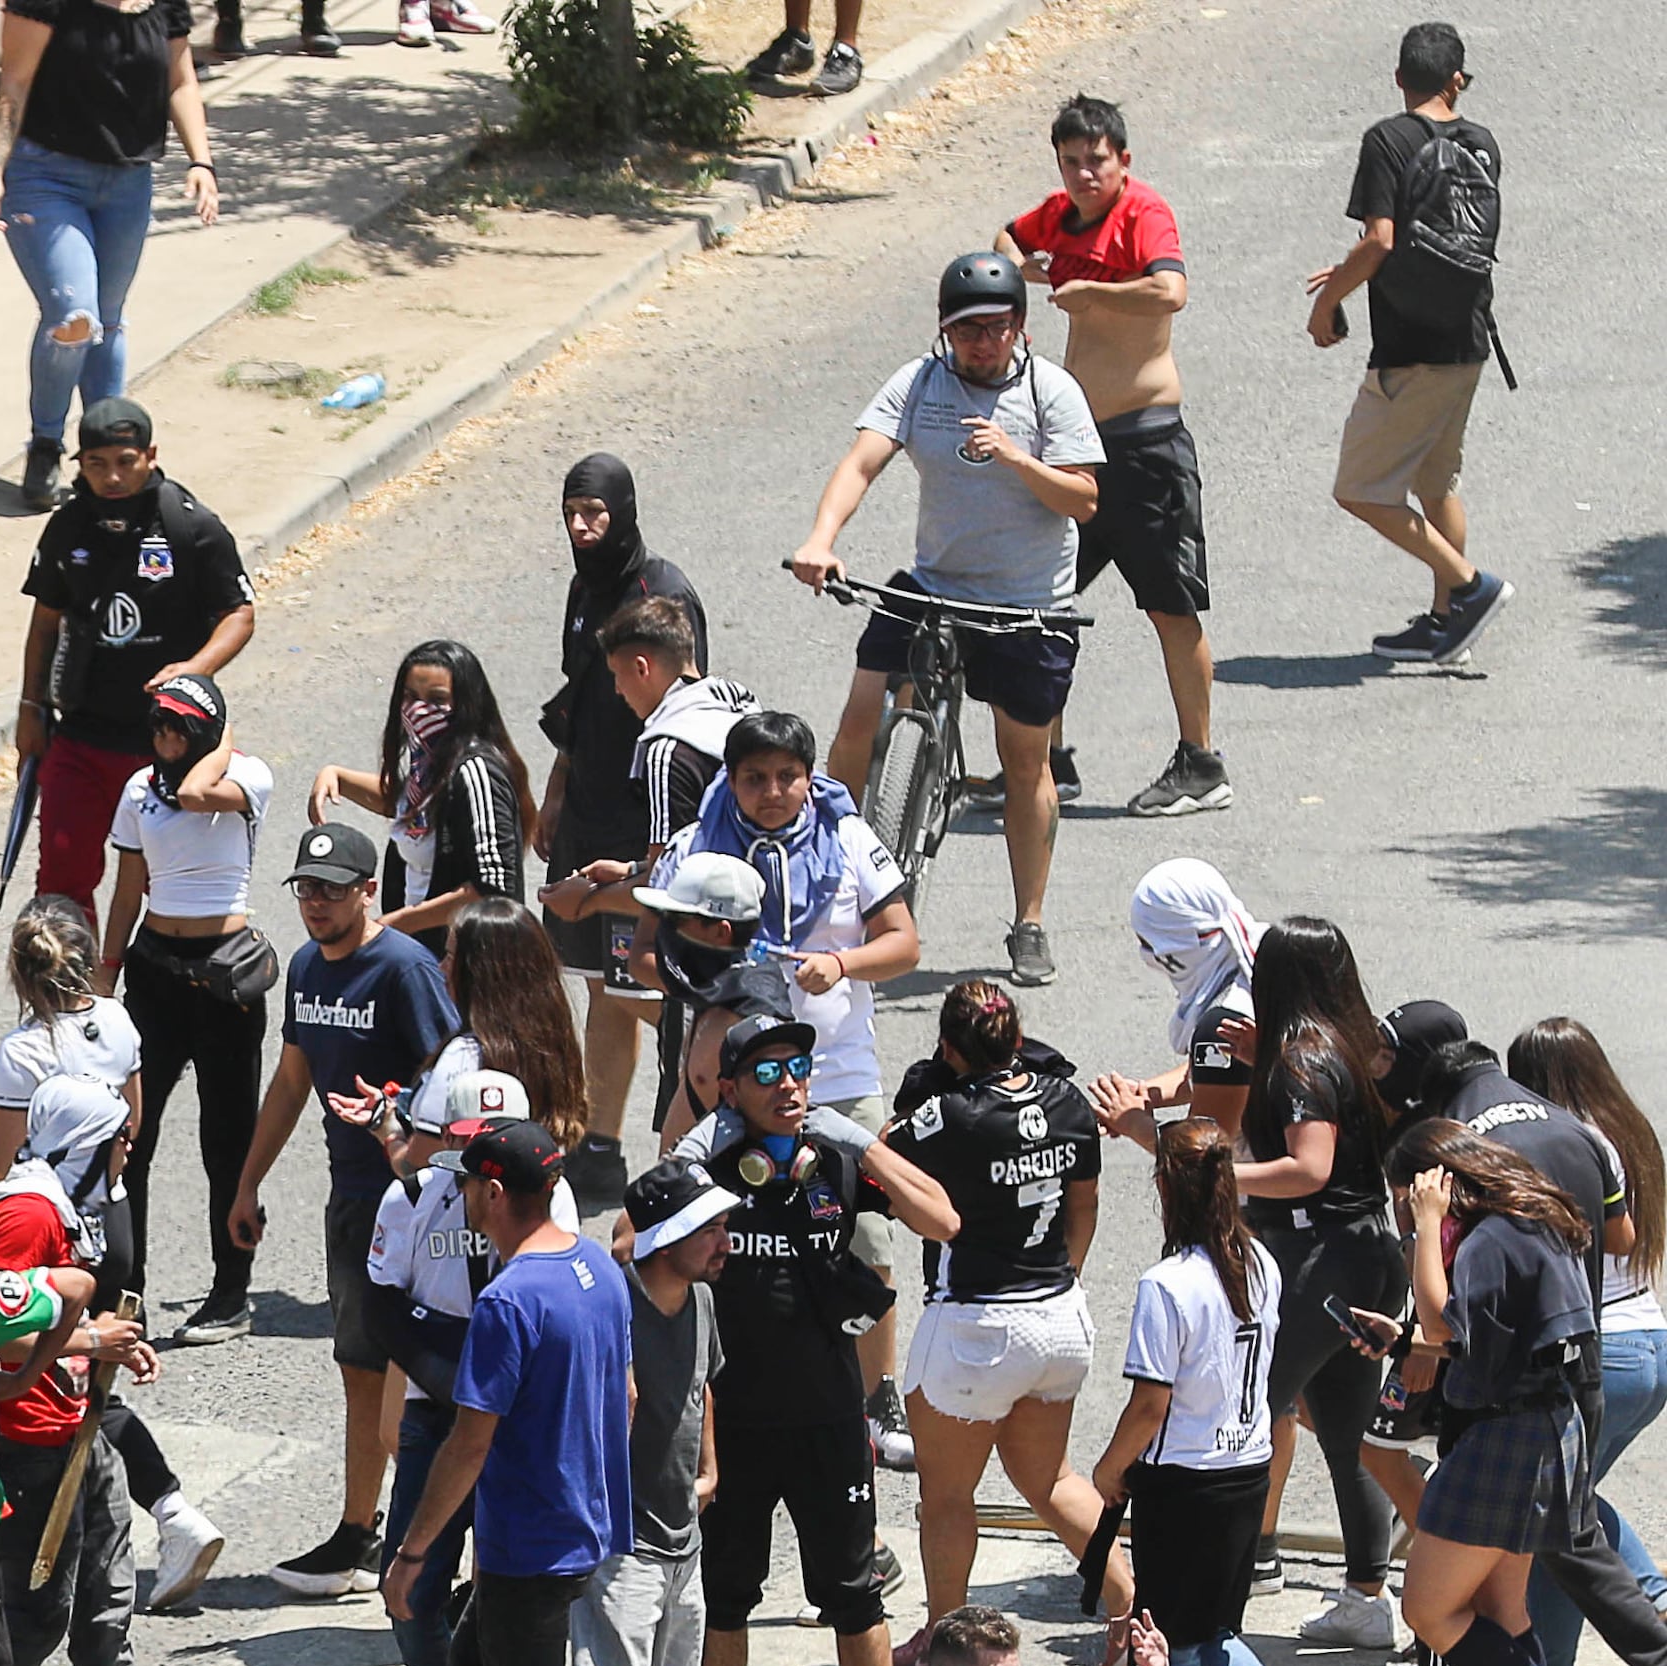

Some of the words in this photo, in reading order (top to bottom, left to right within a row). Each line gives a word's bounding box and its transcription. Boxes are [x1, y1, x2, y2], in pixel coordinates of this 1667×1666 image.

[294, 992, 375, 1029] Timberland
[1468, 1102, 1549, 1135] DIRECTV
[990, 1143, 1076, 1185] PAREDES
[428, 1229, 490, 1260] DIRE
[728, 1229, 841, 1257] DIRETV
